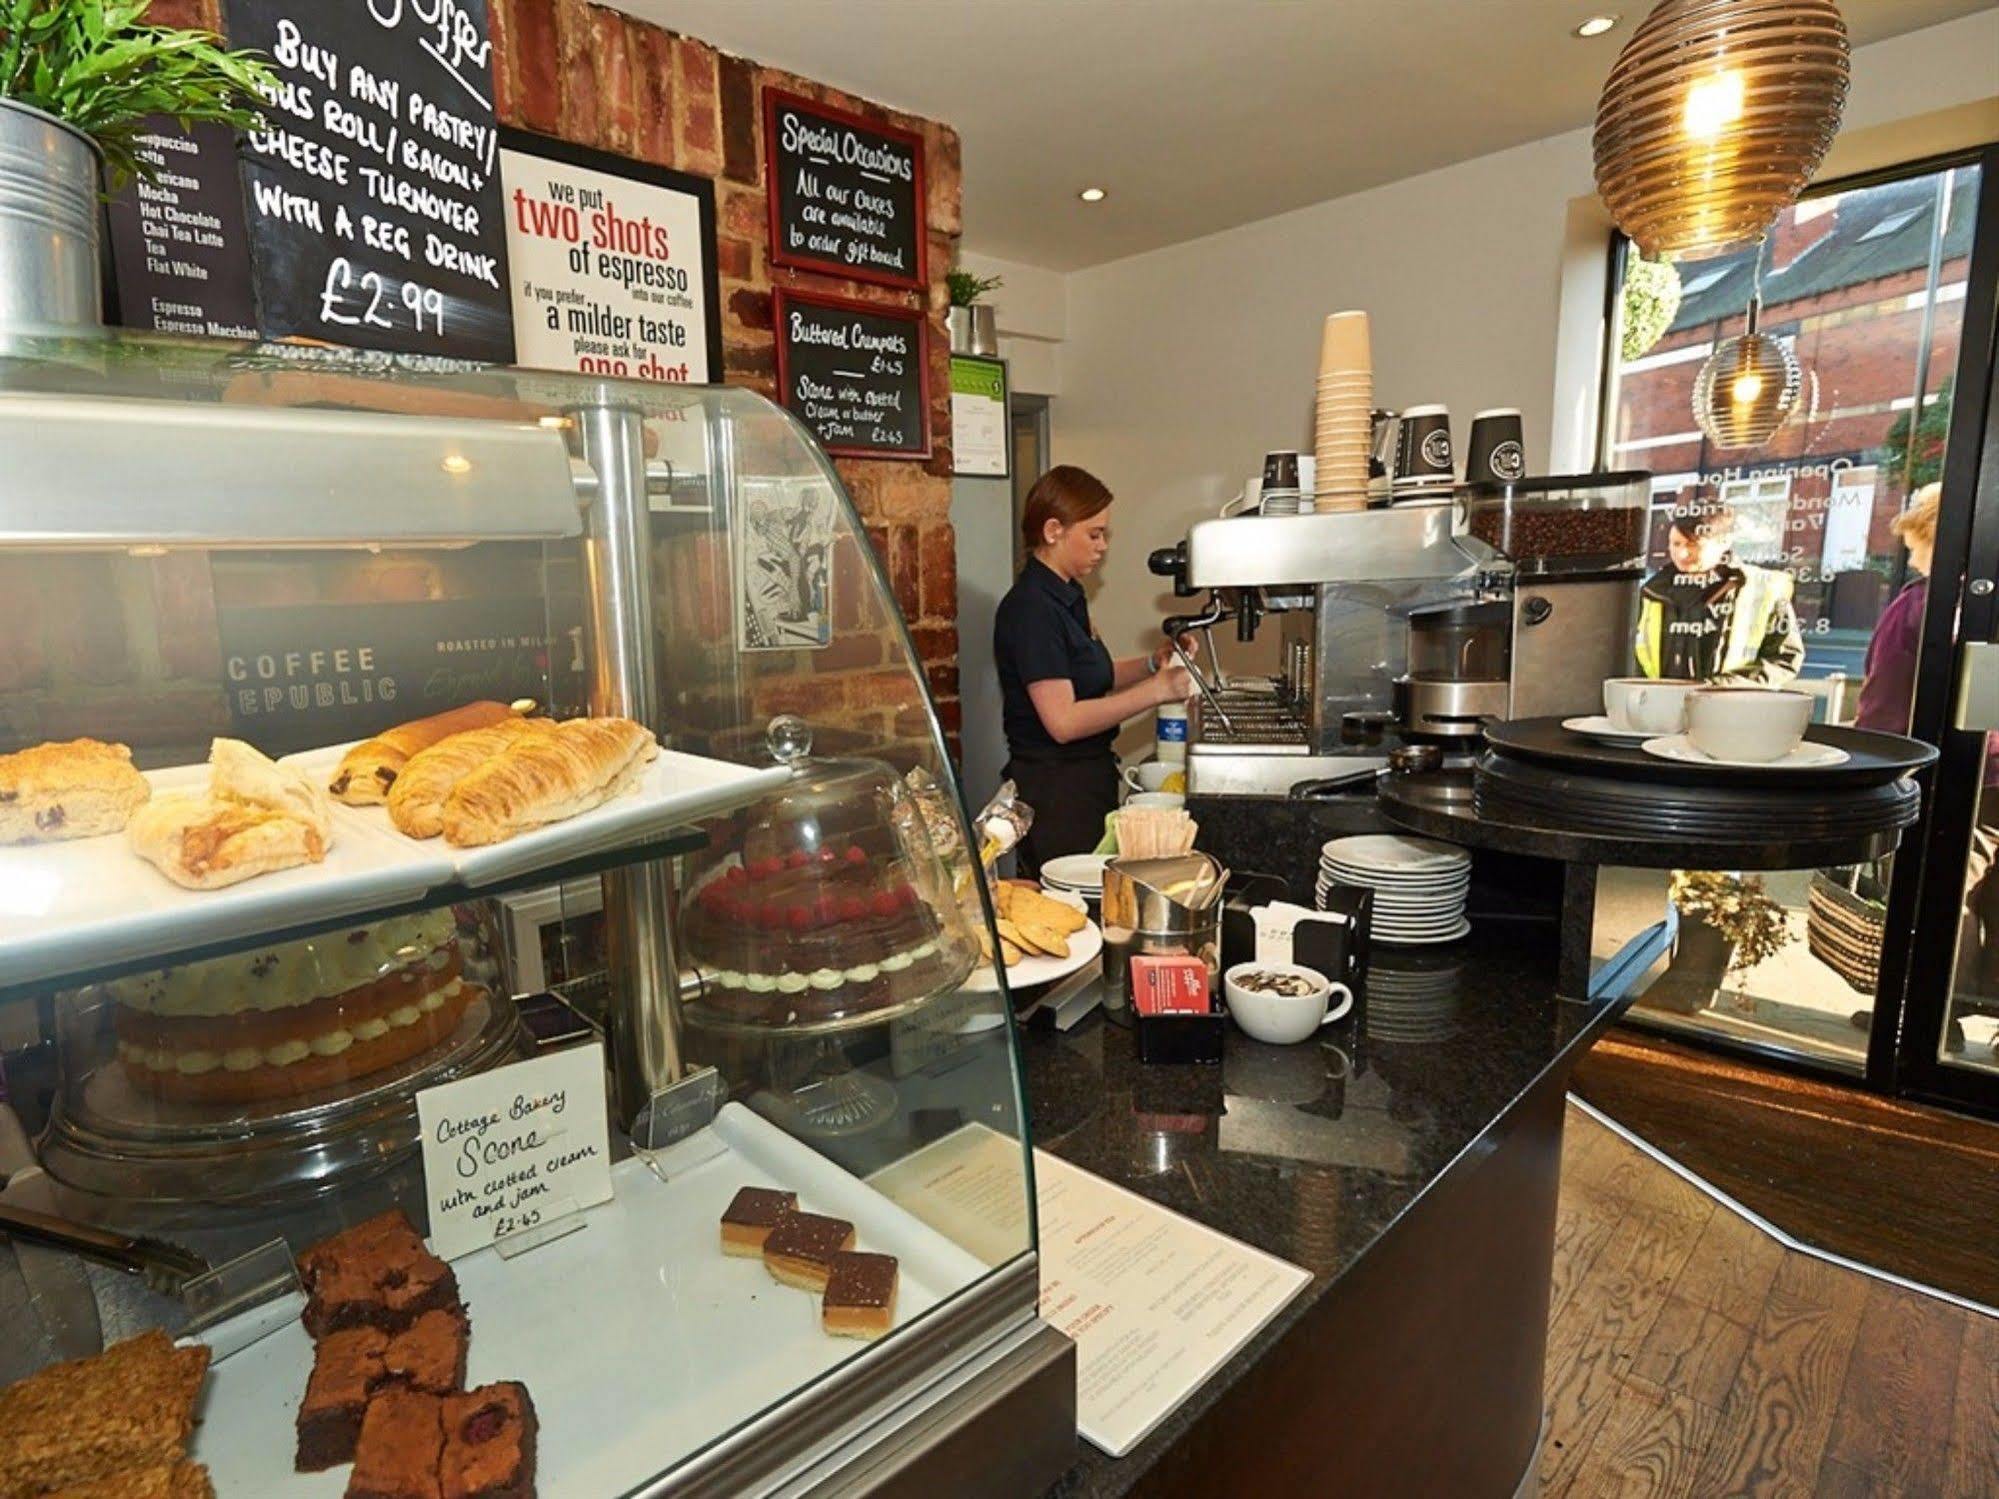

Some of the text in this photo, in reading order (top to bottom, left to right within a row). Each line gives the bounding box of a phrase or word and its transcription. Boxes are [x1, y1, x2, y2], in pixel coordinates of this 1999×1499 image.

[349, 66, 399, 120] ANY
[782, 112, 913, 181] Special Occasions
[249, 127, 480, 237] CHEESE TURNOVER
[548, 181, 604, 211] we put
[796, 167, 822, 198] All
[826, 184, 850, 205] our
[140, 201, 222, 230] Hot Chocolate
[513, 188, 669, 261] two shots
[802, 204, 827, 225] are
[145, 238, 166, 256] Tea
[171, 224, 192, 242] Tea
[193, 228, 224, 248] Latte
[253, 180, 500, 290] WITH A REG DRINK
[790, 223, 806, 248] to
[808, 234, 842, 255] order
[147, 257, 208, 280] Flat White
[569, 241, 688, 293] of espresso
[151, 296, 203, 319] Espresso
[320, 257, 444, 337] £2.99
[153, 314, 205, 335] Espresso
[546, 302, 687, 347] a milder taste
[790, 311, 907, 355] Buttered Crumpets
[573, 336, 648, 359] please ask for
[796, 374, 834, 401] Scone
[228, 647, 375, 681] COFFEE
[436, 638, 497, 653] ROASTED
[238, 676, 398, 716] EPUBLIC
[436, 1090, 566, 1144] Cottage Bakery
[456, 1130, 547, 1178] Scone
[440, 1145, 599, 1212] with clotted cream
[472, 1183, 551, 1219] and jam
